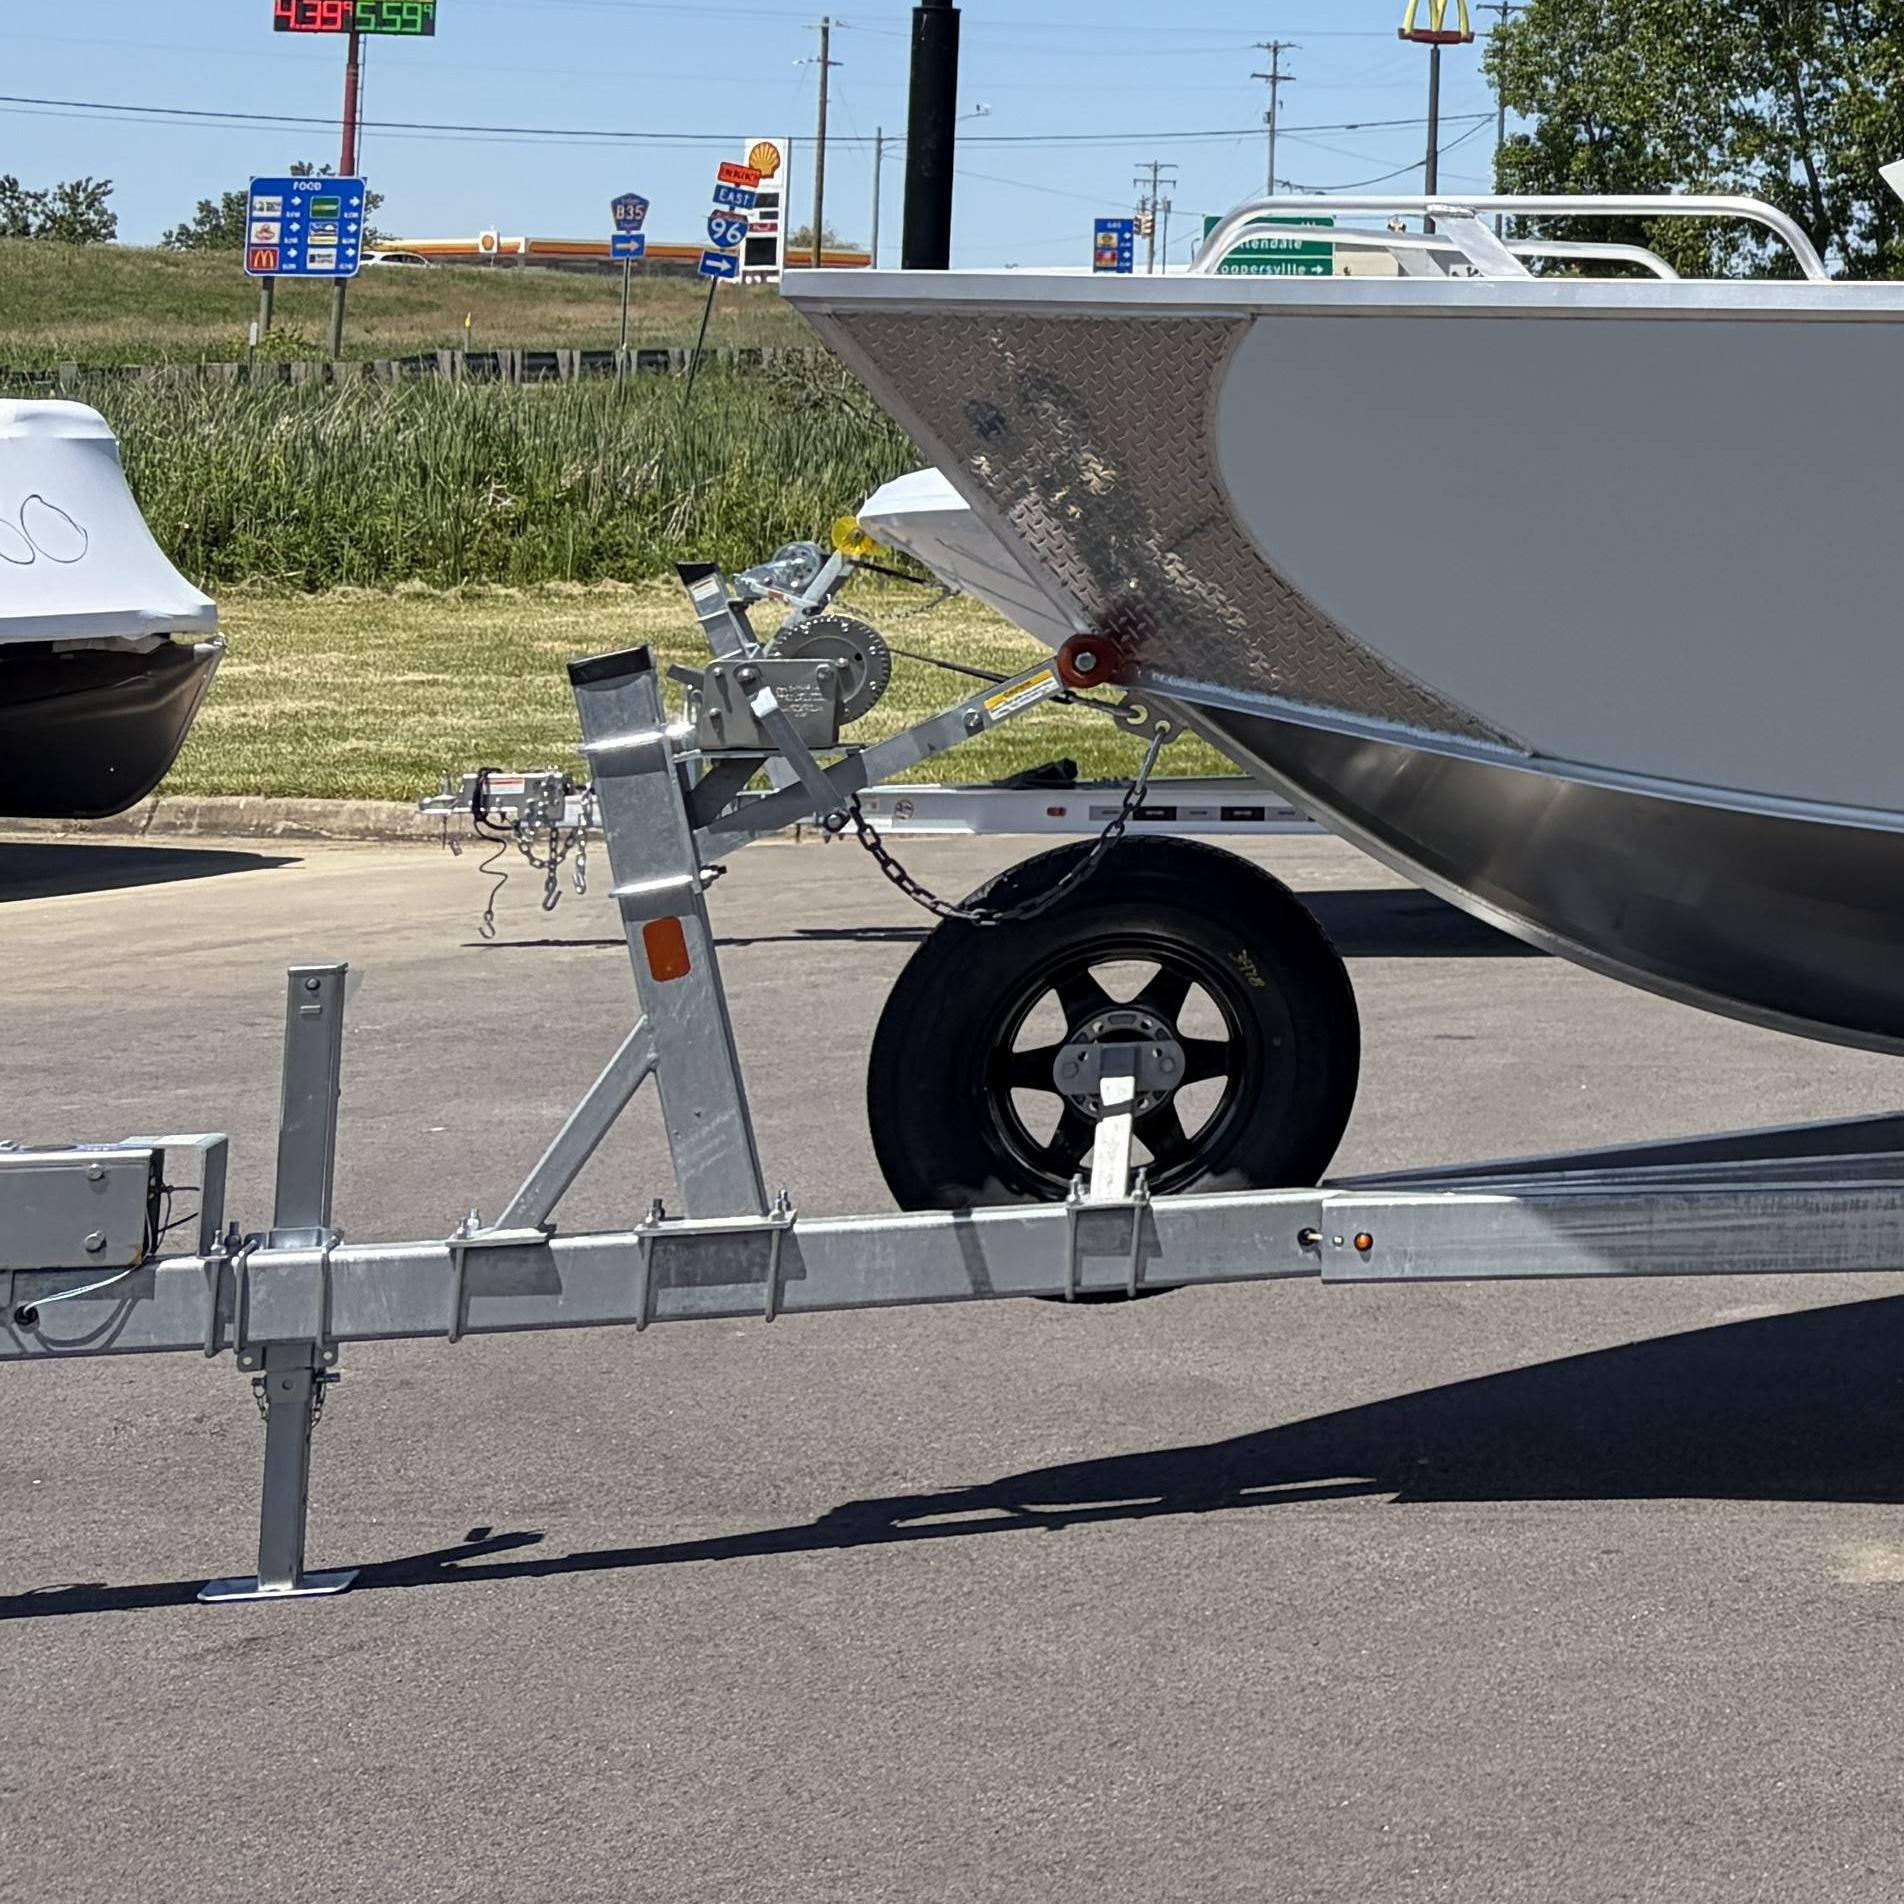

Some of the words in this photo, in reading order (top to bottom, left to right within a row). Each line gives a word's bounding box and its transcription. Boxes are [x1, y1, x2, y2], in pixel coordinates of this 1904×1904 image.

[293, 181, 322, 191] FOOD
[719, 188, 750, 206] EAST
[711, 218, 742, 244] 96
[1221, 262, 1306, 275] oopersville
